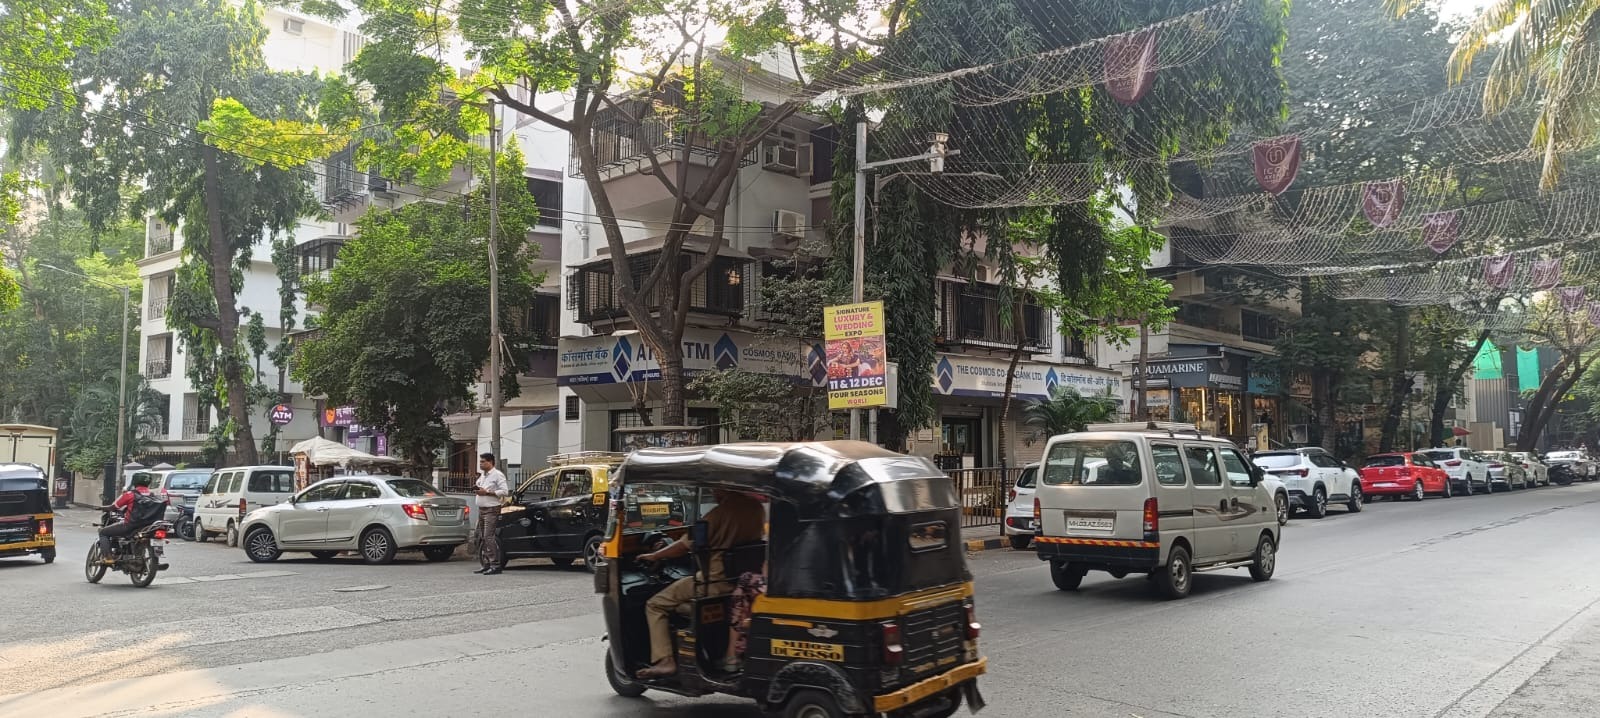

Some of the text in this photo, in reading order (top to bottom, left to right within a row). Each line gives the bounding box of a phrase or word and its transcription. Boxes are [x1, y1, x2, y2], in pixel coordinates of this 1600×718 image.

[836, 307, 869, 315] SIGNATURE
[834, 313, 866, 323] LUXURY
[835, 321, 873, 331] WEDDING
[743, 348, 775, 359] COSMOS
[957, 365, 969, 375] THE
[970, 366, 996, 377] COSMOS
[1016, 370, 1031, 380] BANK
[1133, 363, 1204, 376] AUAMARINE
[830, 376, 883, 390] 11 & 12 DEC
[850, 388, 884, 397] SEASONS
[272, 411, 292, 420] ATM
